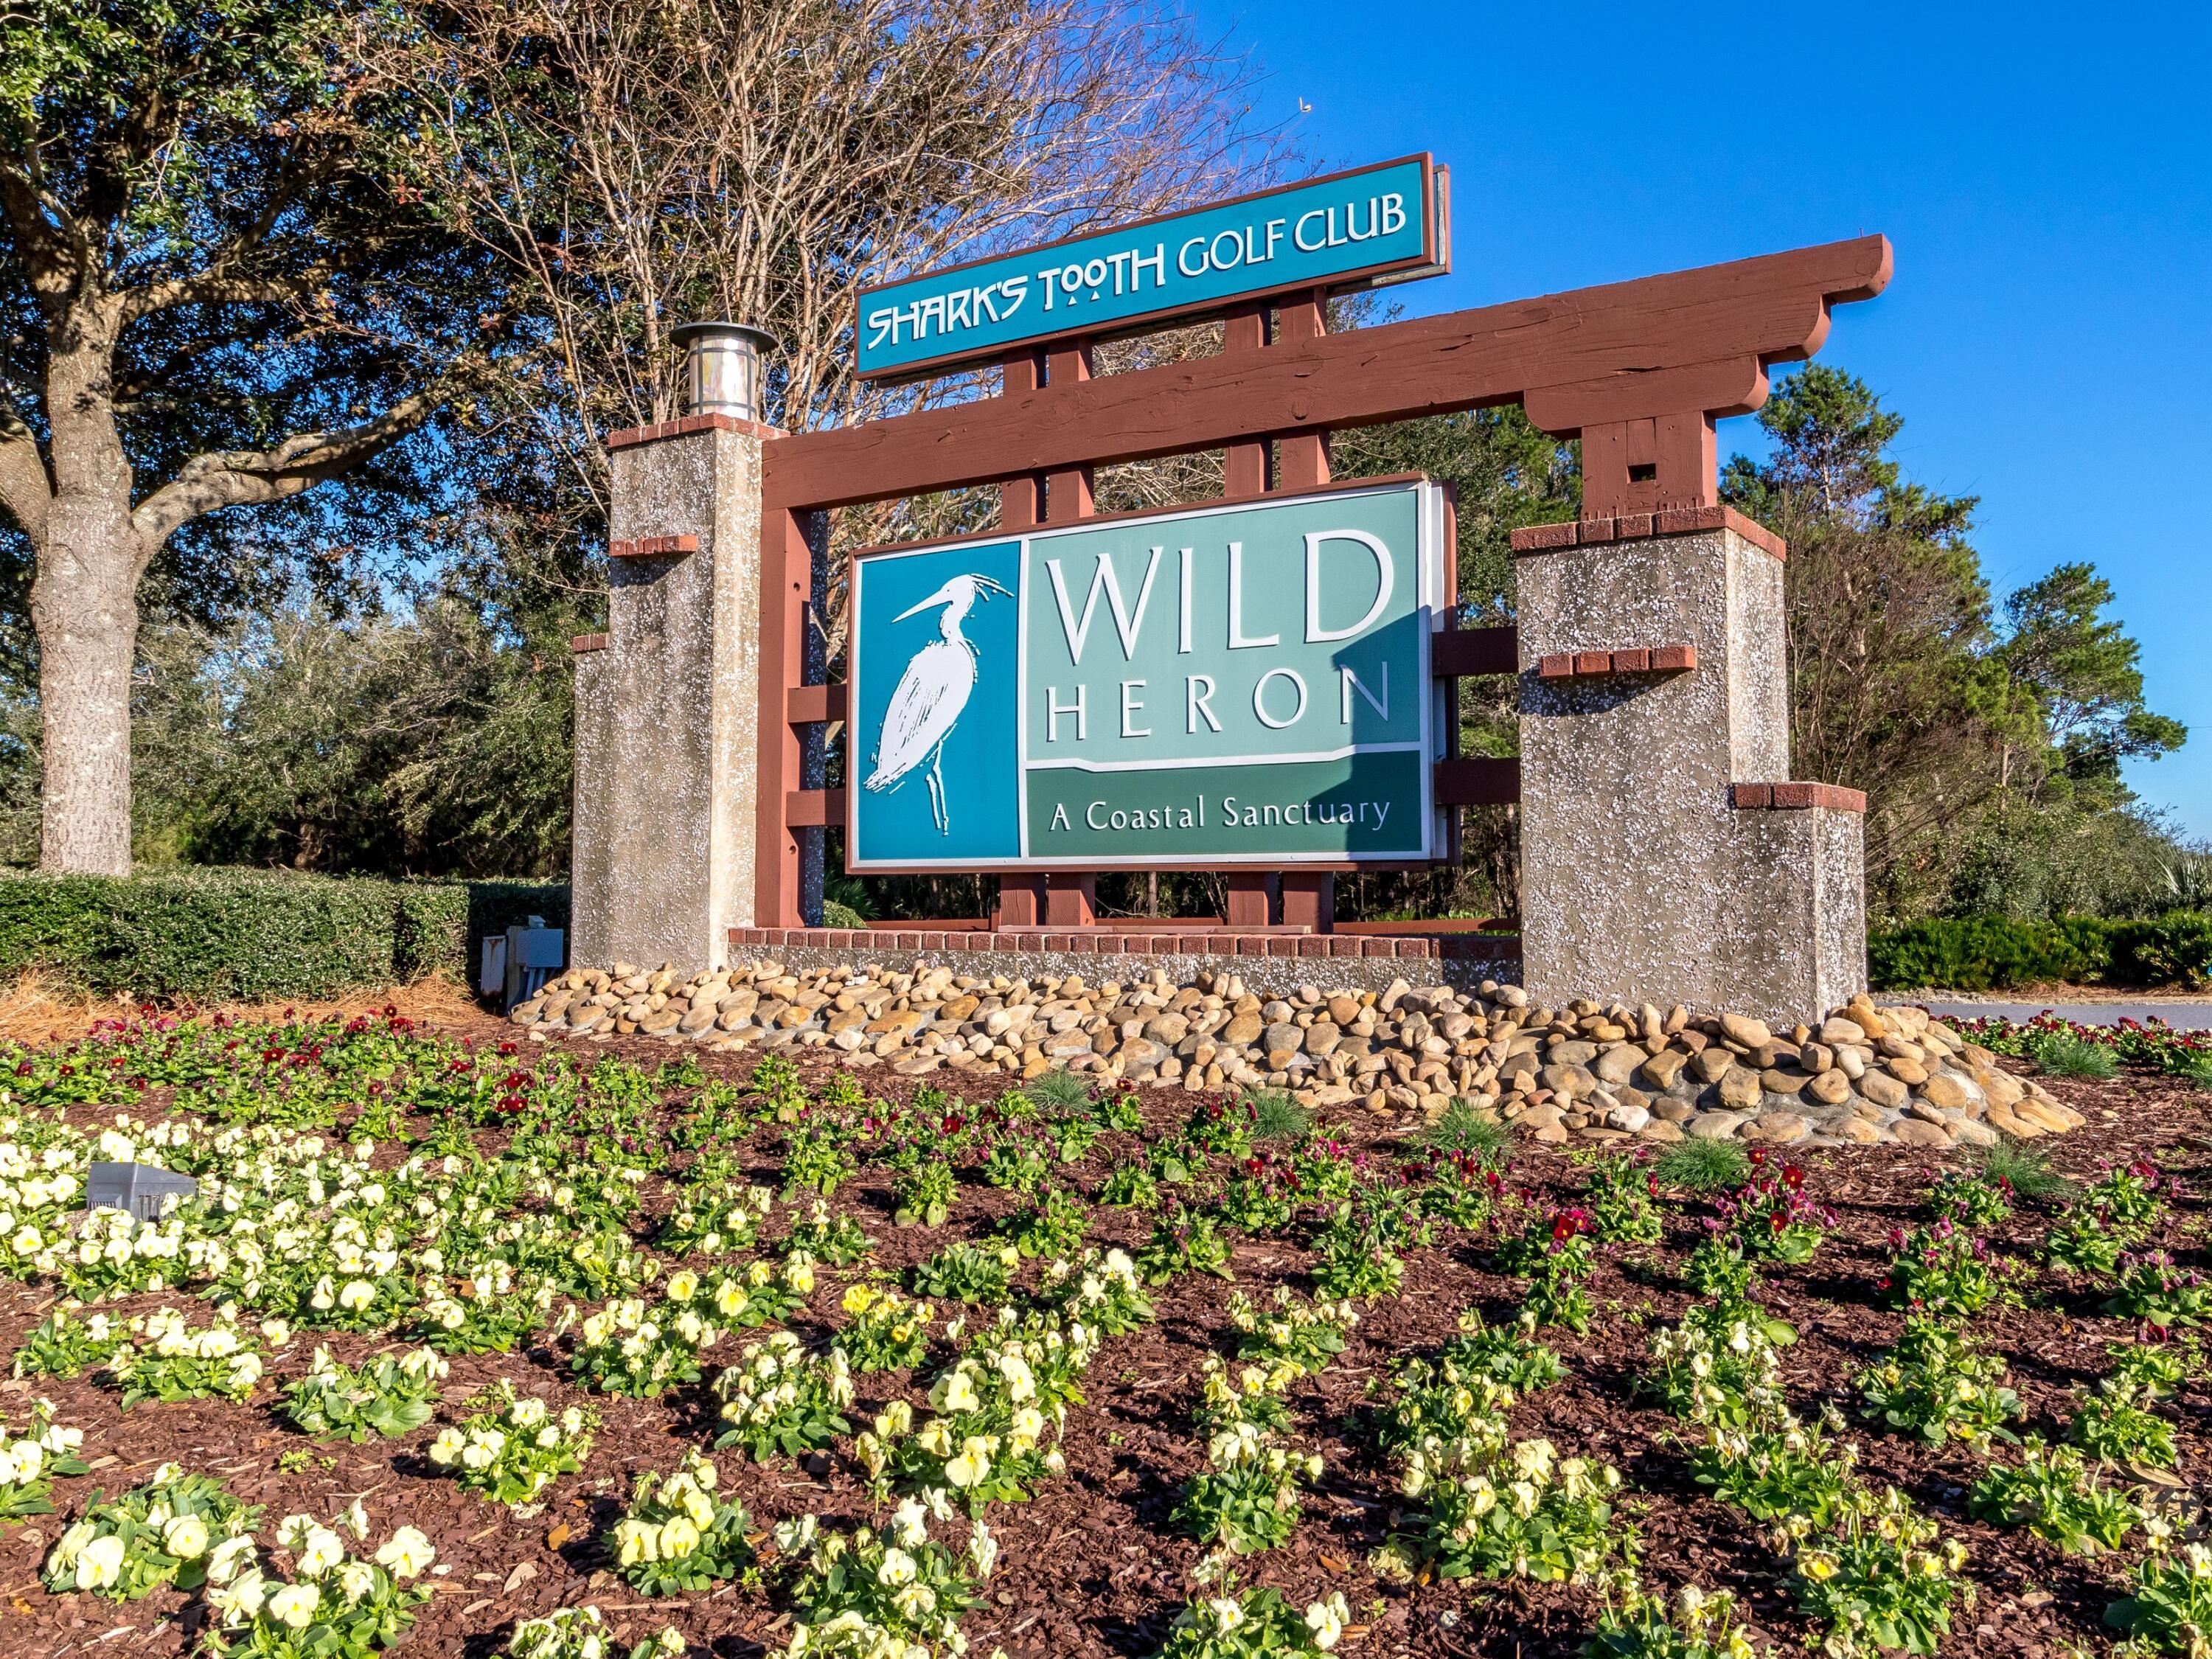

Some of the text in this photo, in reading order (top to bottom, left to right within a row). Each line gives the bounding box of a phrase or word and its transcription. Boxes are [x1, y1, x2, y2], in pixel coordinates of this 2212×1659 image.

[867, 193, 1407, 350] SHARK'S TOOTH GOLF CLUB
[1046, 529, 1394, 665] WILD
[1047, 661, 1389, 742] HERON
[1049, 795, 1391, 831] A Coastal Sanctuary
